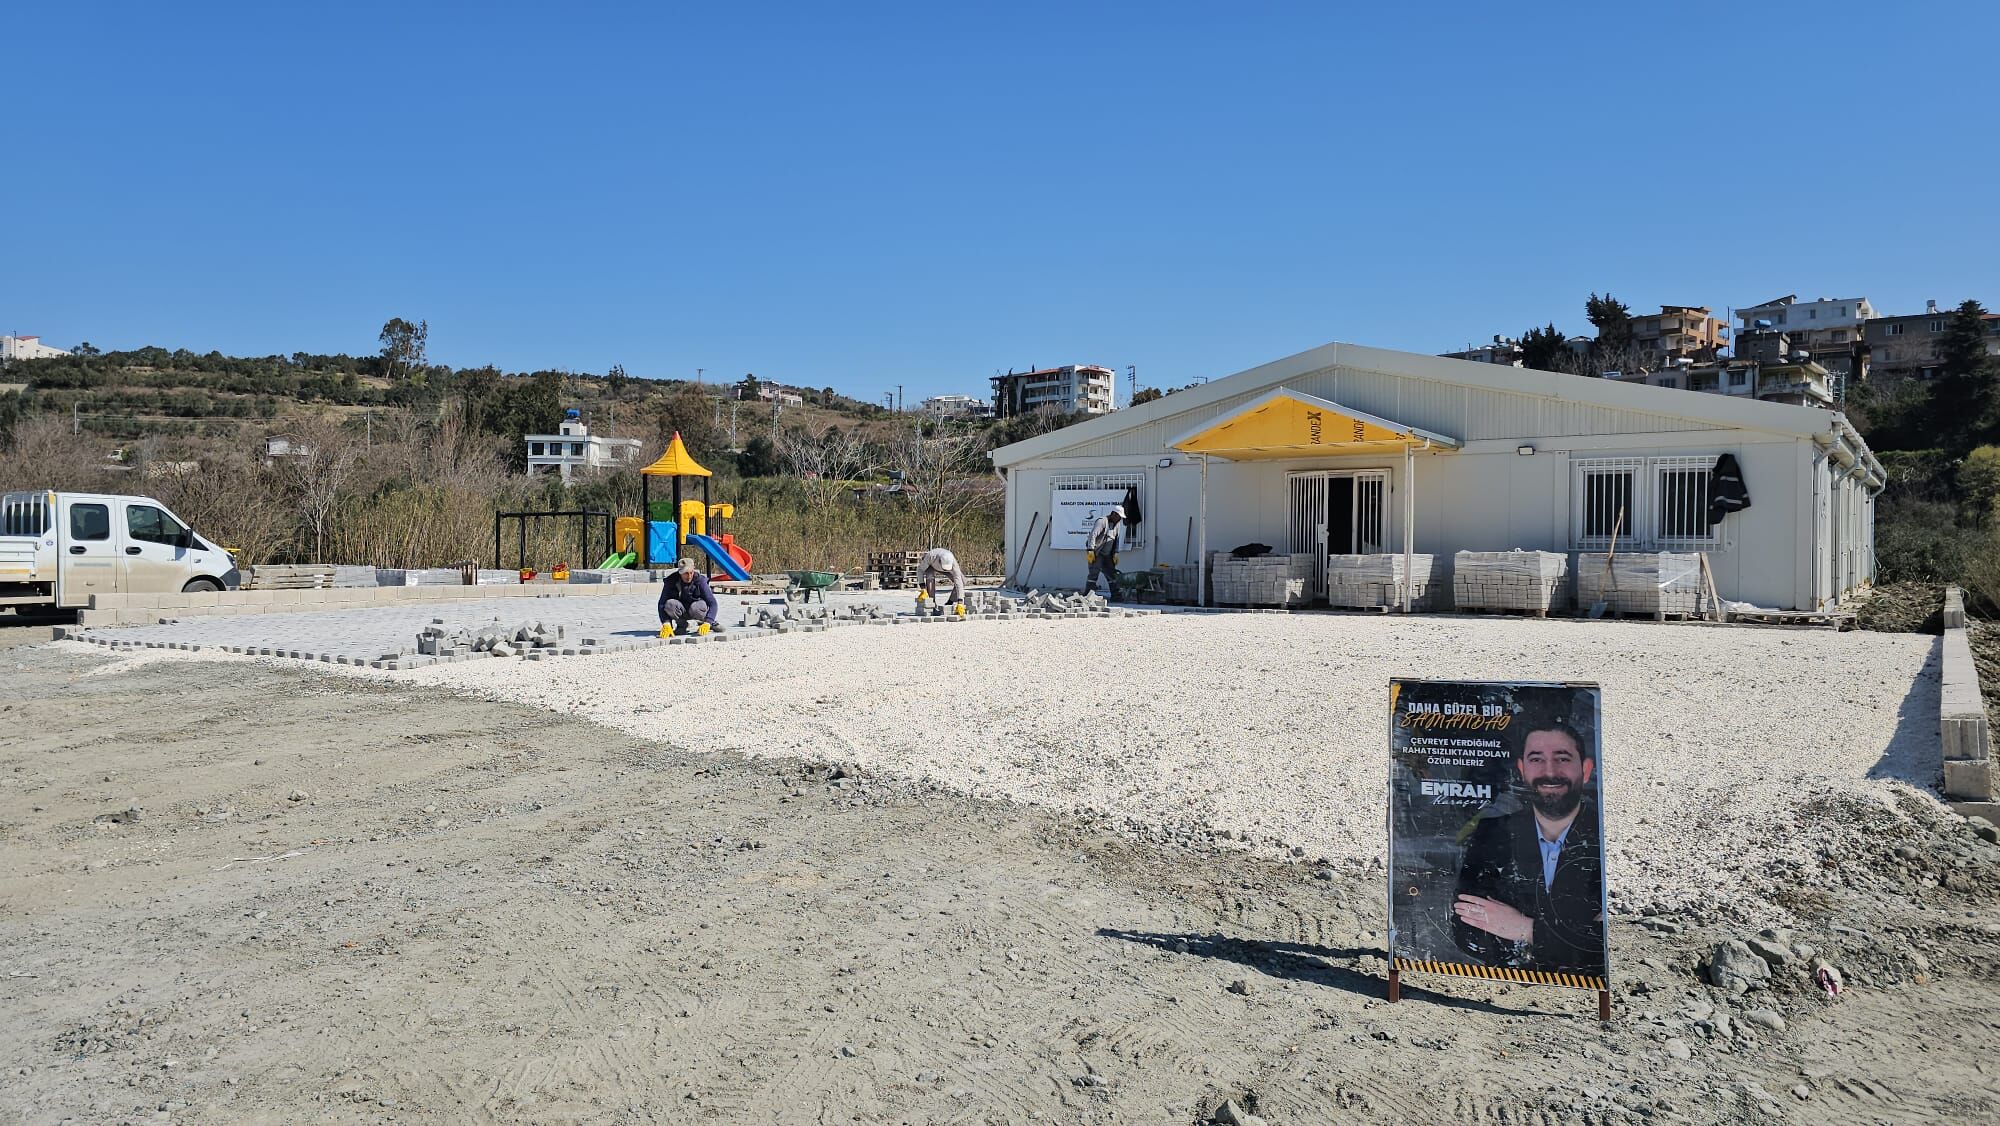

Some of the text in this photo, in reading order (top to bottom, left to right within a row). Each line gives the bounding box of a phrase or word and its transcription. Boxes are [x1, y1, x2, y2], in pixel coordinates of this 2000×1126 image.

[1408, 702, 1503, 717] DAHA GÜZEL BİR
[1400, 712, 1511, 731] SAMANDAĞ
[1410, 737, 1502, 748] ÇEVREYE VERDİĞİMİZ
[1402, 746, 1510, 758] RAHATSIZLIKTAN DOLAYI
[1427, 755, 1485, 767] ÖZÜR DİLERİZ
[1421, 782, 1491, 798] EMRAH
[1432, 795, 1492, 810] Karaçay
